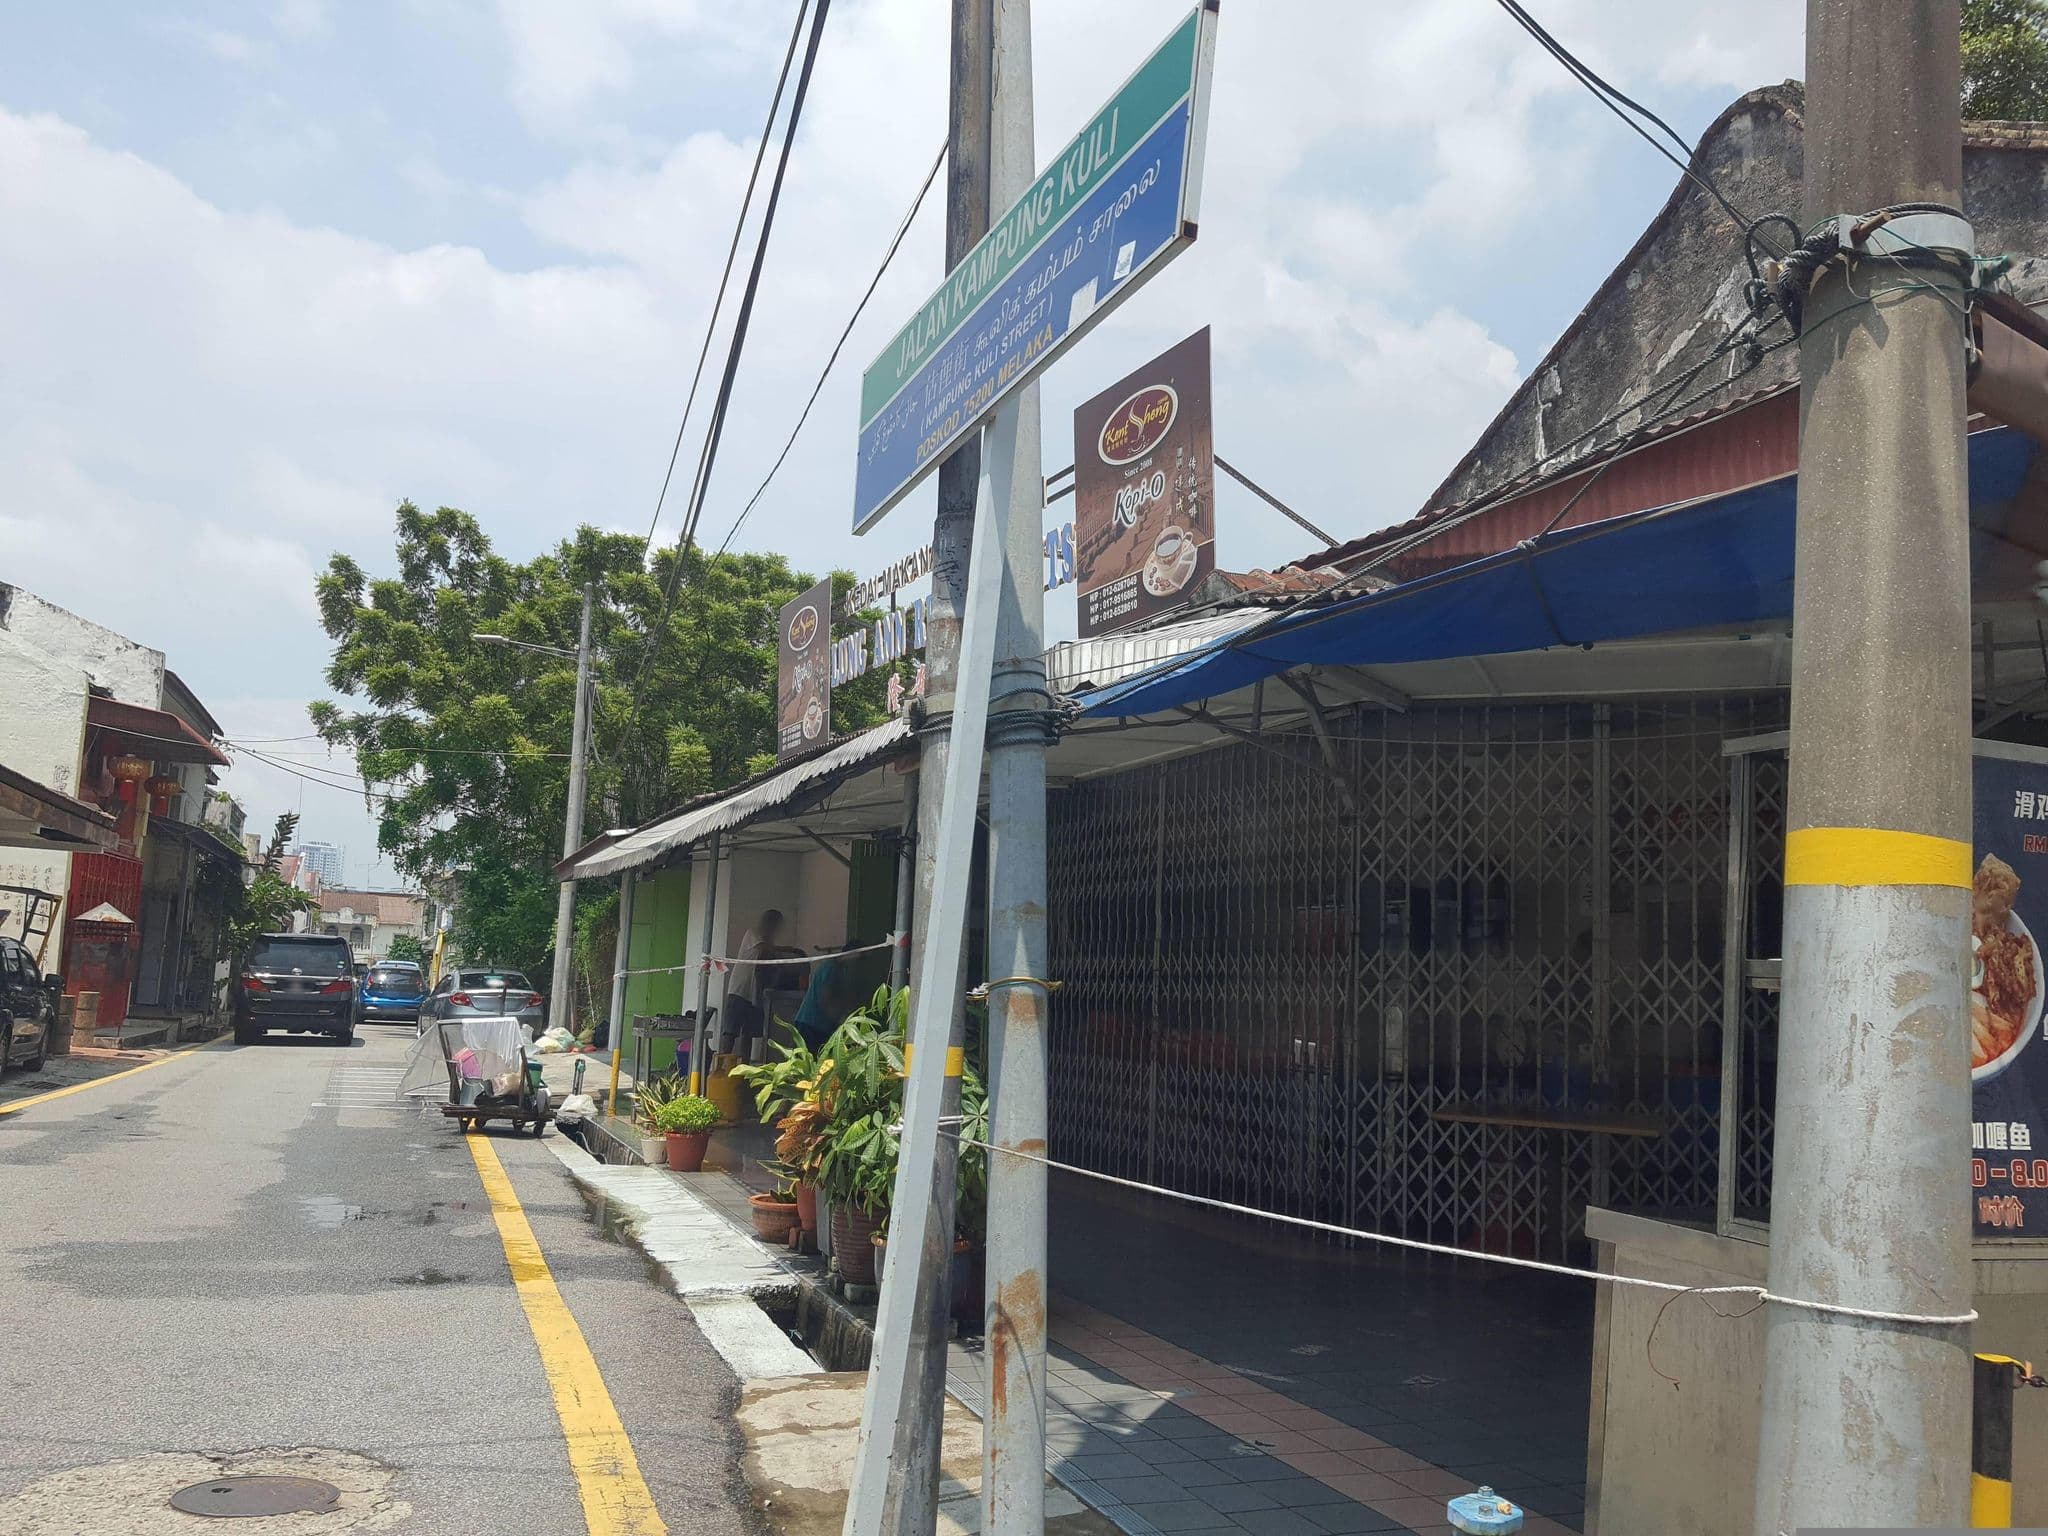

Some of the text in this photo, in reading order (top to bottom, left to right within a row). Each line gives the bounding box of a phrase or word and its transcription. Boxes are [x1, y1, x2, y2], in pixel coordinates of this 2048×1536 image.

[897, 106, 1118, 378] JALAN KAMPUNG KULI
[916, 322, 1053, 464] POSKOD 75200 MELAKA
[926, 373, 971, 427] KAMPUNG
[974, 348, 998, 382] KULI
[1001, 298, 1046, 354] STREET
[1113, 470, 1165, 526] Kopi-O
[1124, 466, 1139, 479] Since
[873, 607, 908, 669] ANN
[2023, 834, 2048, 853] RM
